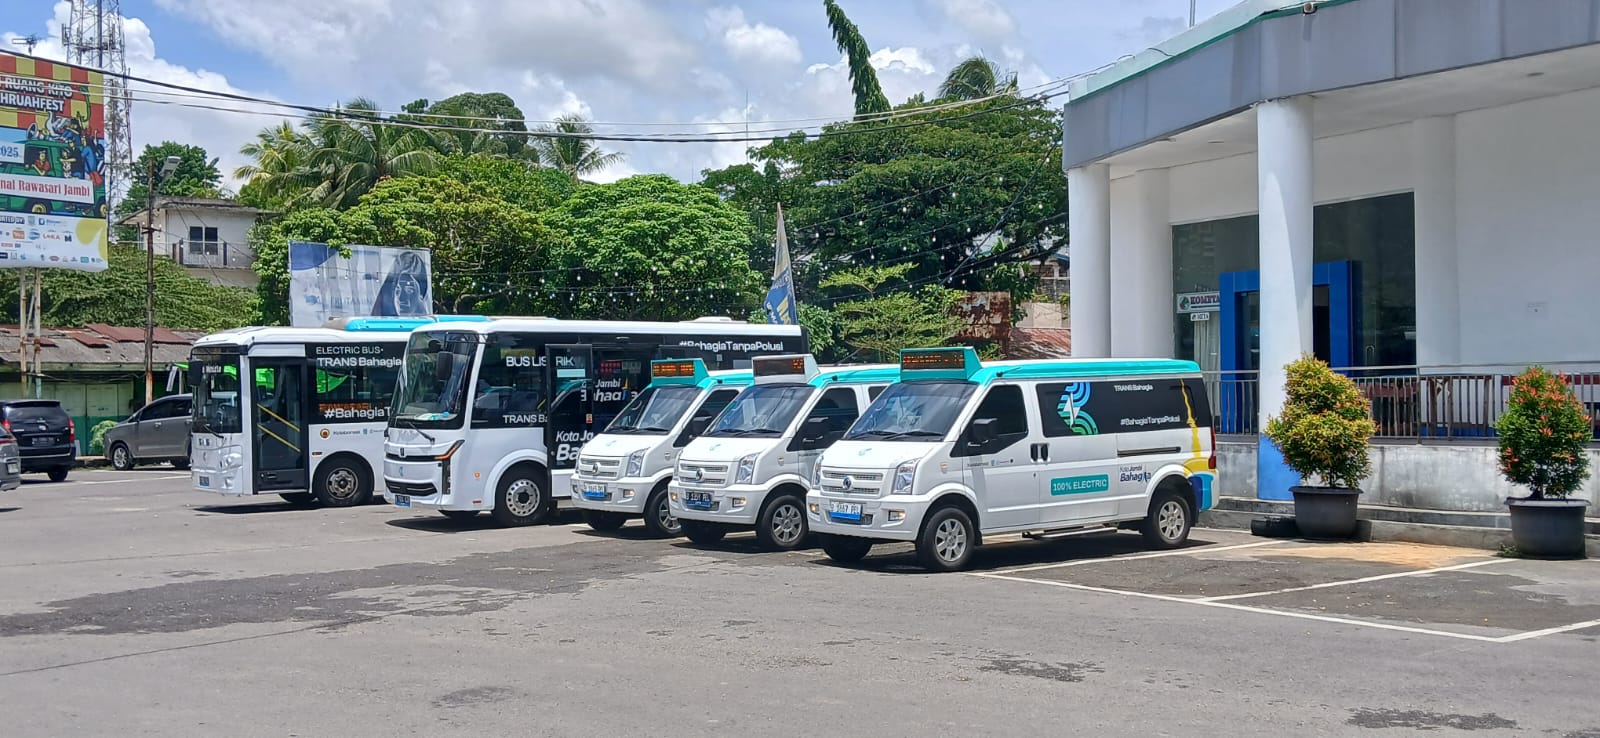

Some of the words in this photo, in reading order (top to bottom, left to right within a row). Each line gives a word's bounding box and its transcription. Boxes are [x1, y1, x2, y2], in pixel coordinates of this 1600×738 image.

[19, 180, 61, 194] Rawasari
[64, 184, 90, 197] Jambi
[316, 346, 360, 355] ELECTRIC
[361, 346, 381, 354] BUS
[316, 357, 358, 367] TRANS
[358, 357, 402, 368] Bahagia
[505, 355, 531, 367] BUS
[502, 414, 537, 424] TRANS
[556, 430, 579, 442] Kota
[1053, 481, 1072, 491] 100%
[1073, 478, 1108, 490] ELECTRIC
